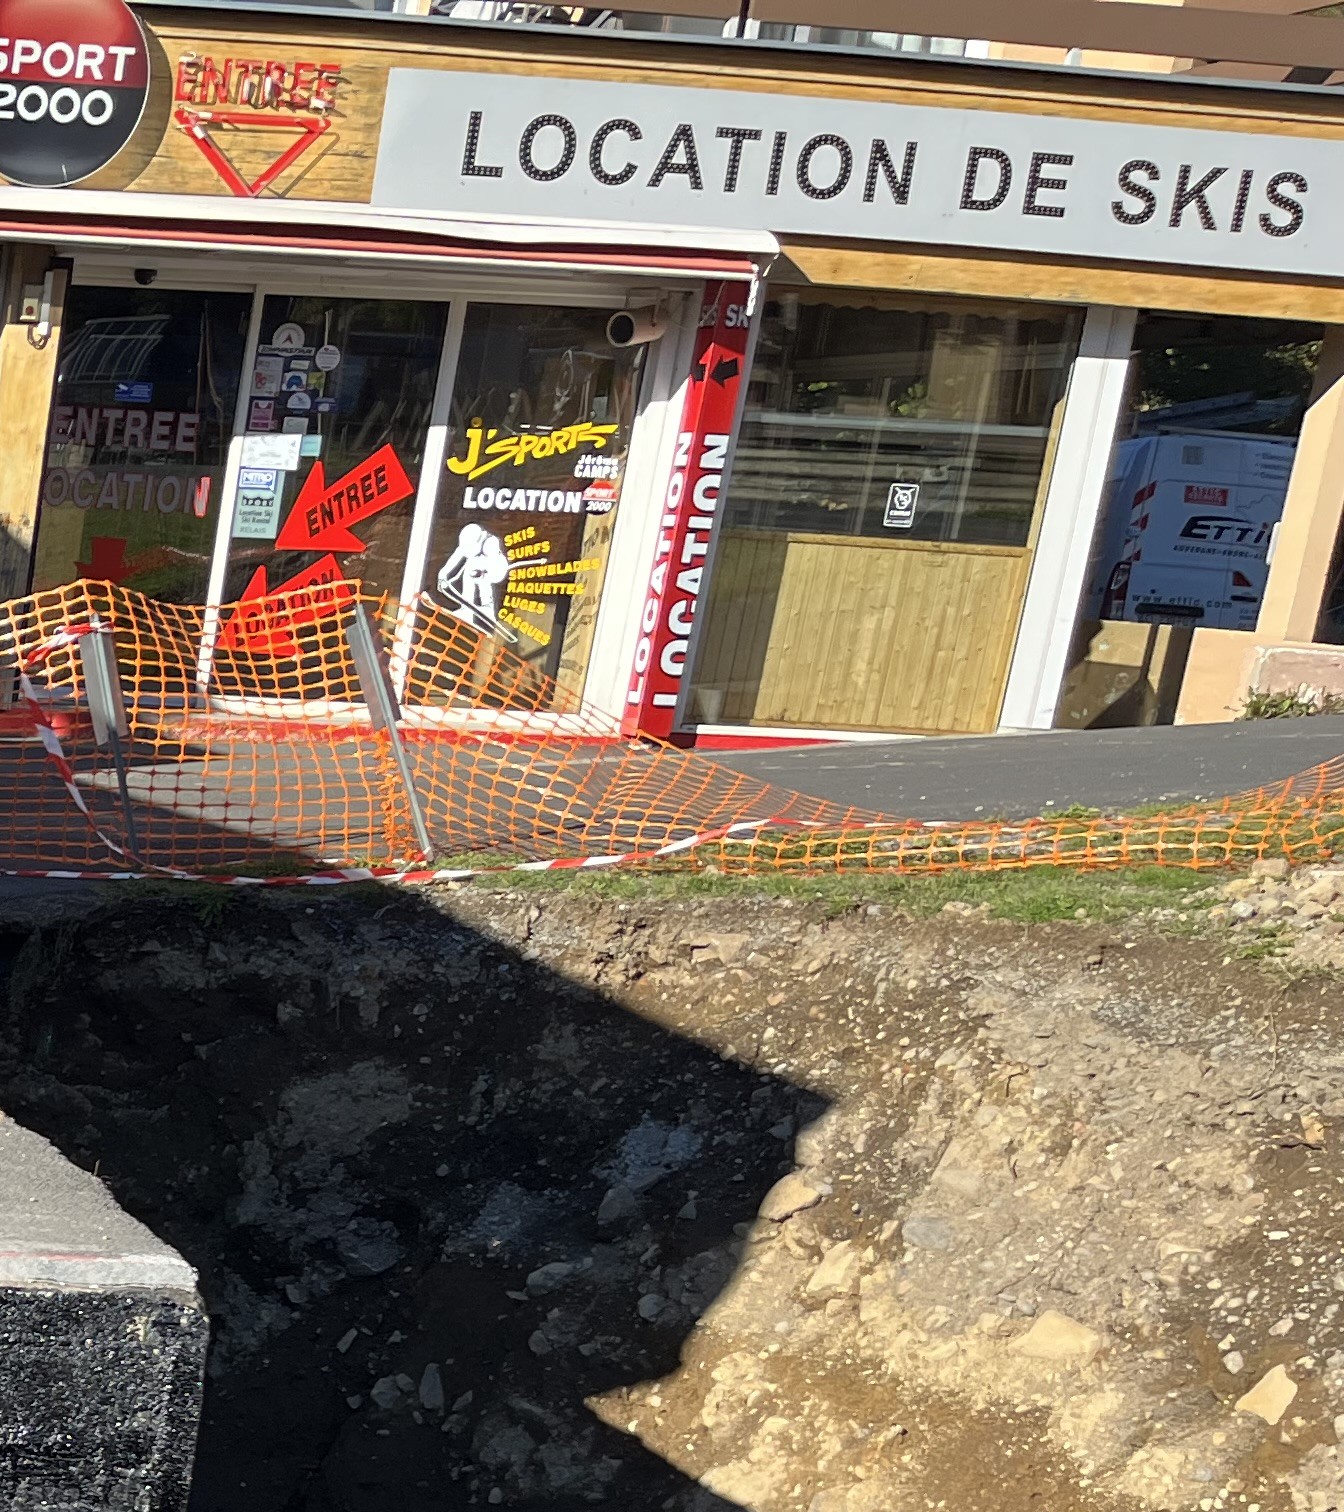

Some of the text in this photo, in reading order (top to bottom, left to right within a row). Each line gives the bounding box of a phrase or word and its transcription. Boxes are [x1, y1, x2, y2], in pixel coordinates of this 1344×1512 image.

[174, 56, 342, 109] ENTREE
[461, 111, 1311, 238] LOCATION DE SKIS
[49, 405, 201, 452] ENTREE
[573, 464, 619, 479] CAMPS
[43, 467, 212, 518] OCATION
[305, 463, 389, 539] ENTREE
[462, 486, 583, 513] LOCATION
[585, 500, 612, 512] 2000
[503, 526, 536, 547] SKIS
[506, 541, 551, 561] SURFS
[508, 557, 601, 581] SNOWBLADES
[626, 431, 693, 706] LOCATION
[506, 582, 585, 595] RAQUETTES
[502, 595, 547, 615] LUGES
[497, 607, 551, 646] CASQUES
